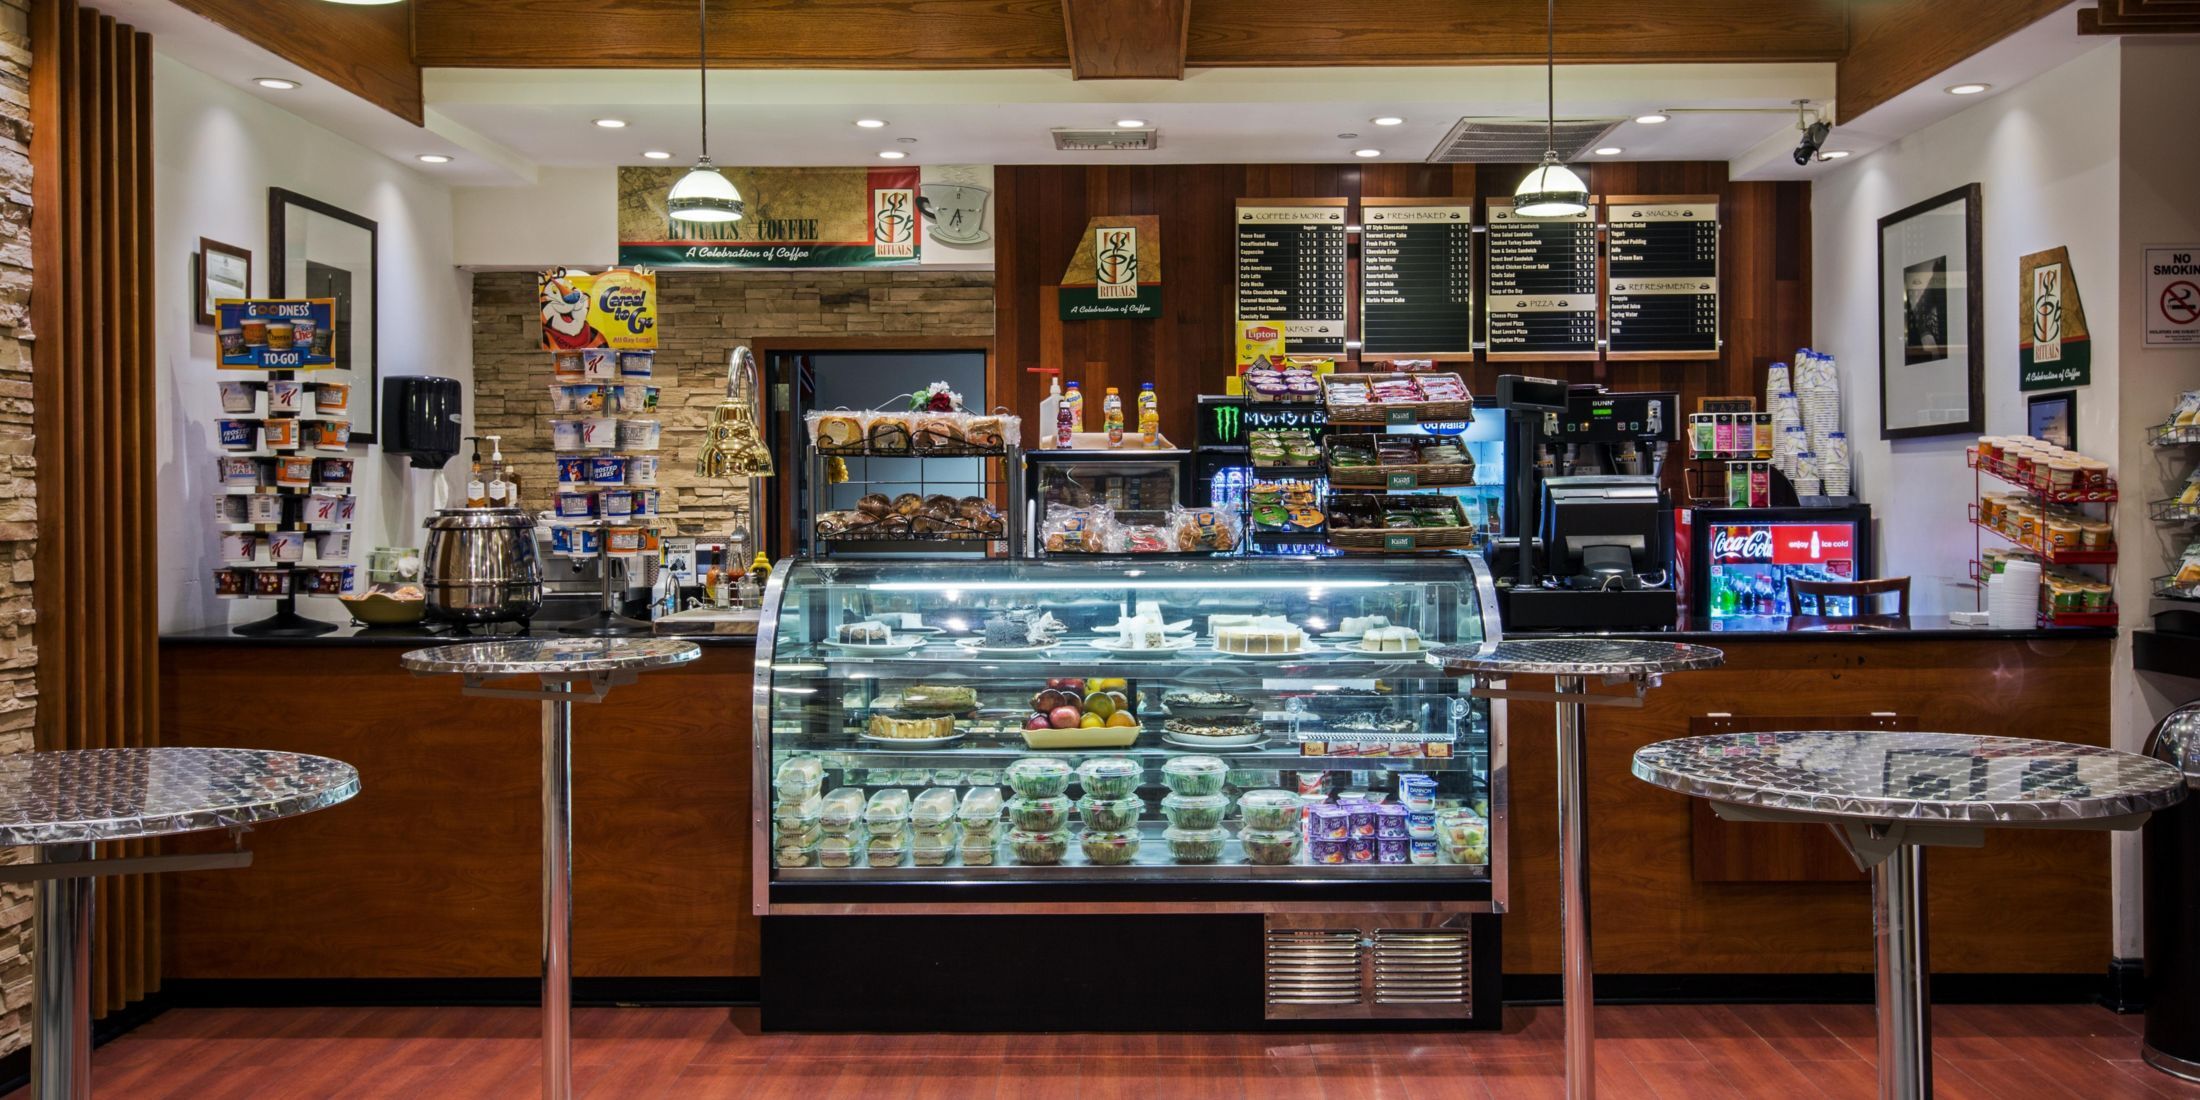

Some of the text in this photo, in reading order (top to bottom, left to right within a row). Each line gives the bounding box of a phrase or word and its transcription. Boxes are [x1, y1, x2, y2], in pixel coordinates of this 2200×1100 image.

[758, 218, 818, 240] COFFEE
[686, 247, 809, 260] A Celebration of Coffee
[877, 244, 913, 257] RITUALS
[2173, 254, 2191, 264] NO
[2153, 265, 2200, 275] SMOKIN
[1100, 285, 1136, 297] RITUALS
[600, 286, 646, 313] Cereal
[248, 305, 310, 316] GOODNESS
[1120, 305, 1129, 314] of
[1129, 304, 1151, 314] Coffee
[614, 307, 653, 334] to Go
[1248, 331, 1277, 339] Lipton
[2035, 344, 2060, 361] RITUALS
[264, 353, 299, 365] TO-GO!
[2031, 369, 2058, 382] Celebration
[2065, 367, 2081, 380] Coffee
[1788, 541, 1809, 549] enjoy
